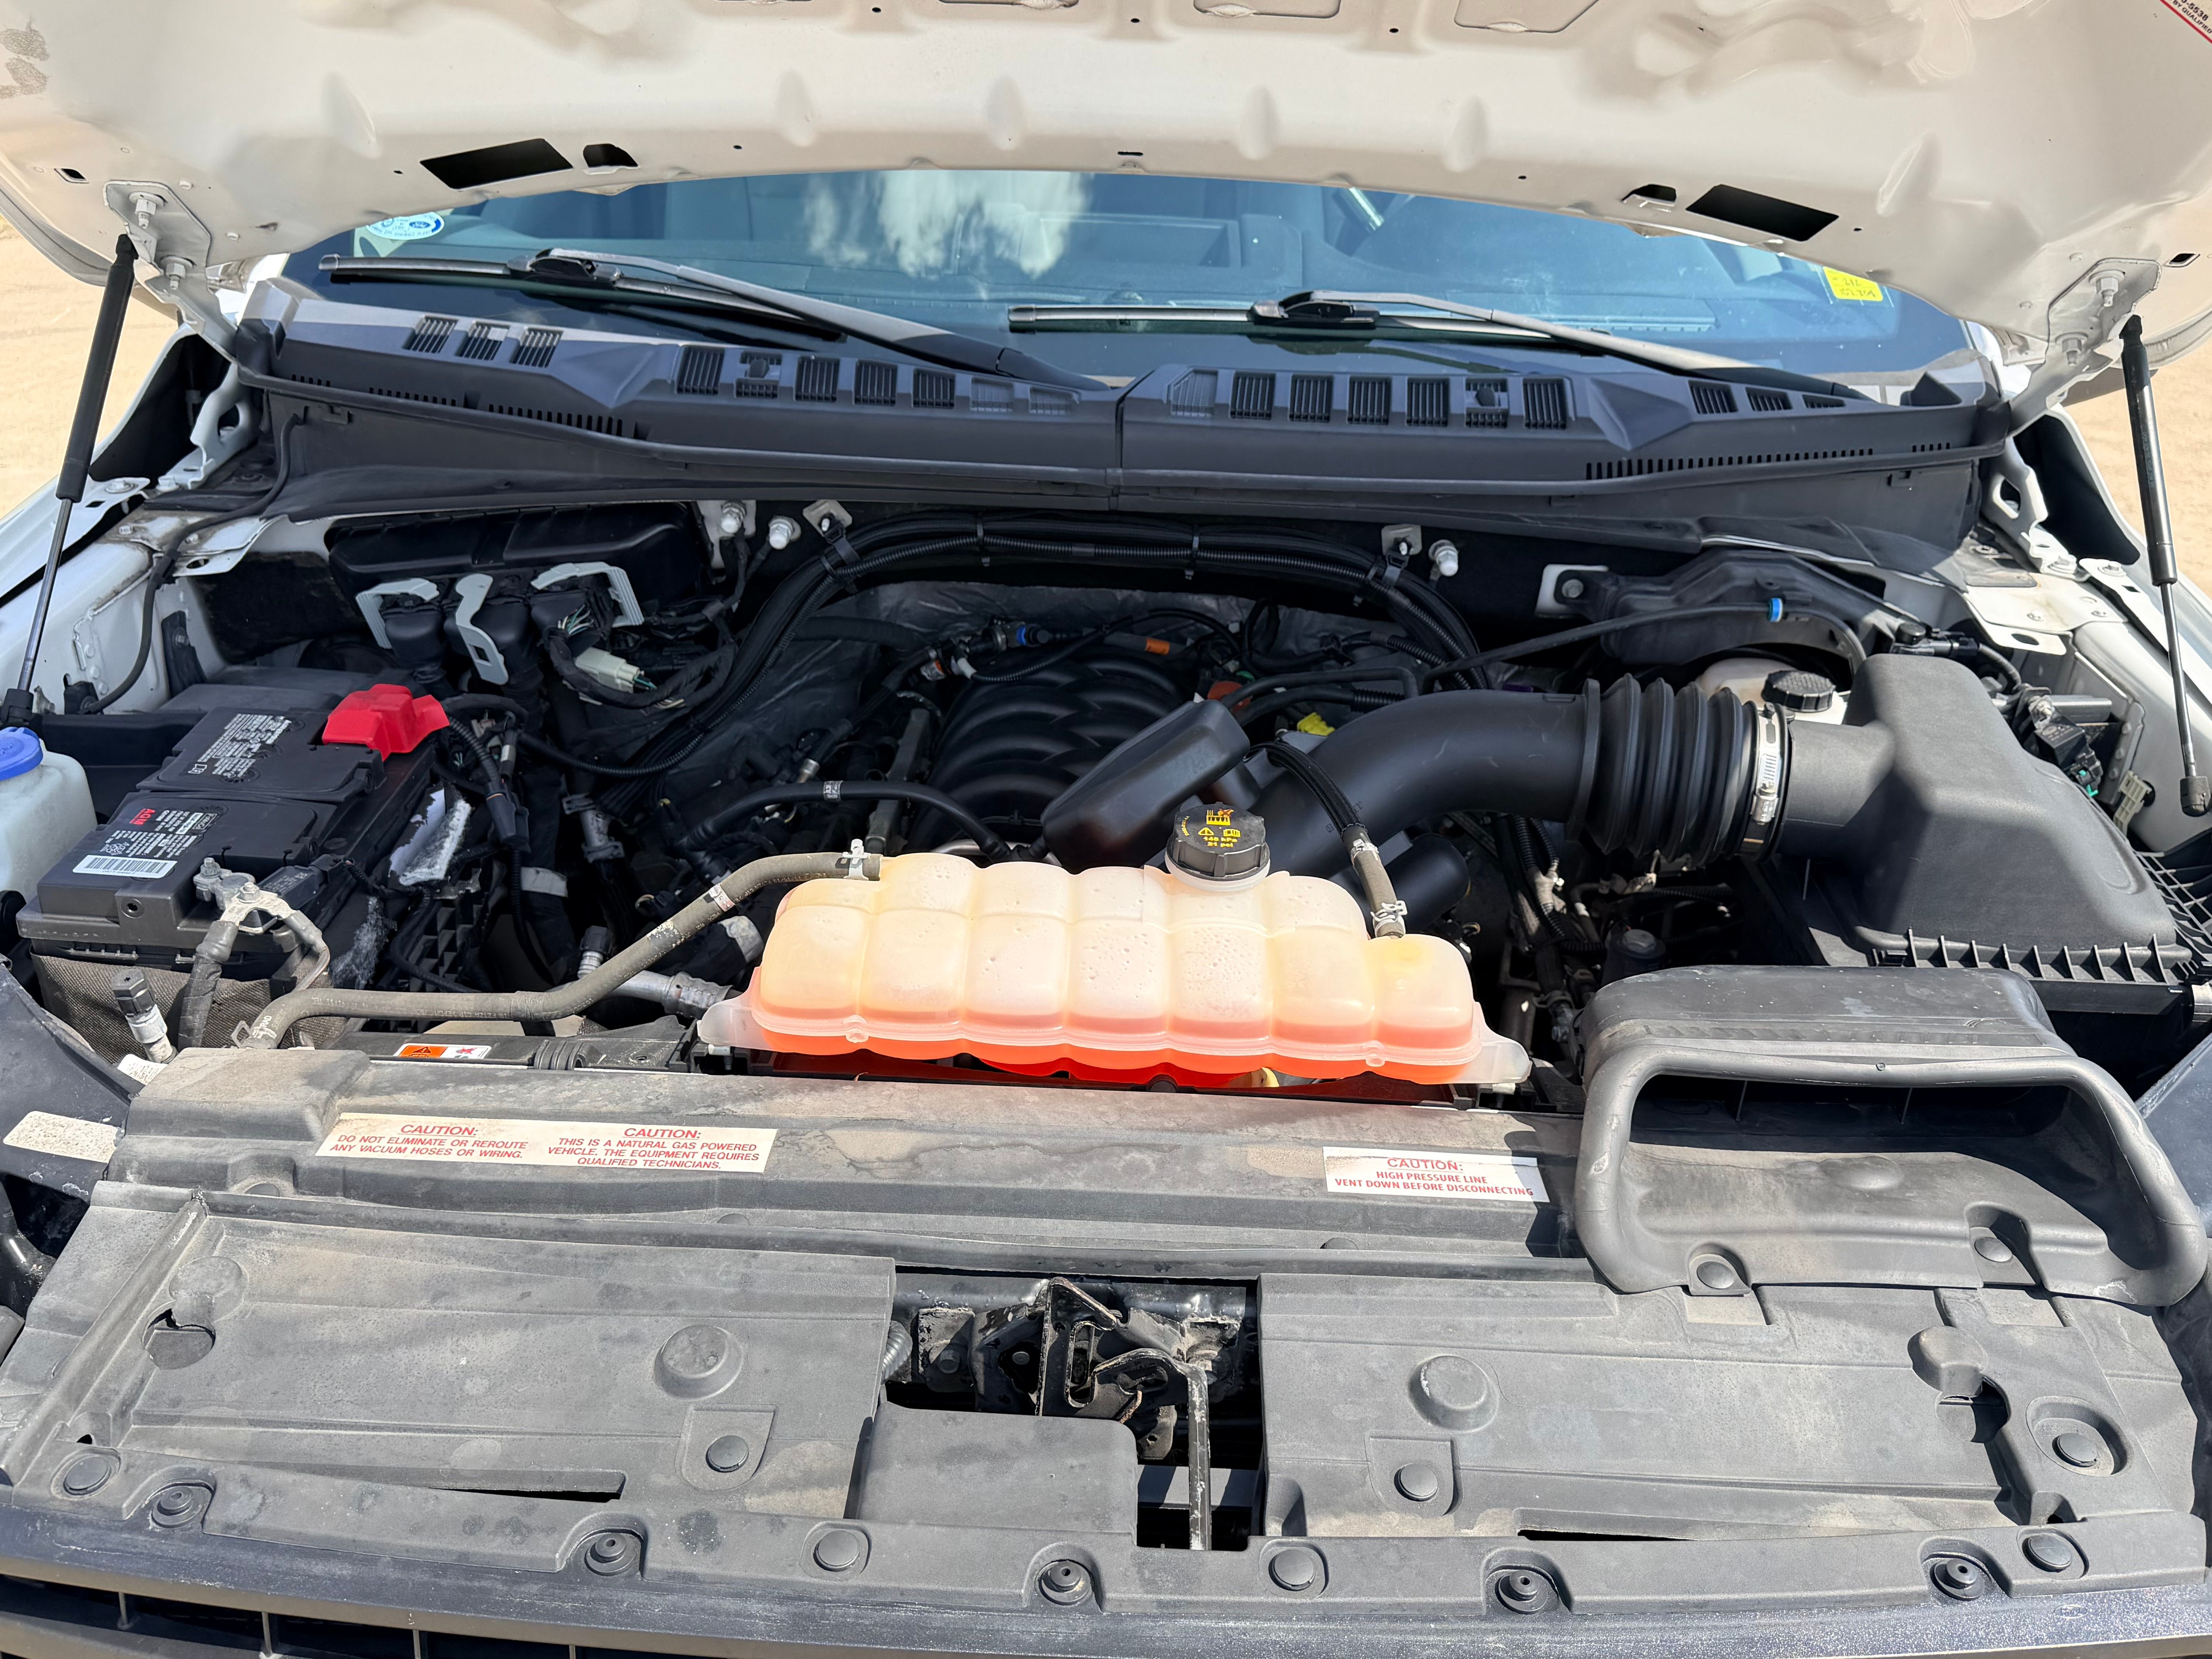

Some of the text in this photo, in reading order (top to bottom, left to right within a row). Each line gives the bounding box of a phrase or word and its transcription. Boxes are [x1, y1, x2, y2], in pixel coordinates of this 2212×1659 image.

[2182, 7, 2212, 34] QUALIFIED
[400, 1124, 478, 1136] CAUTION:
[624, 1128, 702, 1139] CAUTION:
[359, 1135, 385, 1144] NOT
[387, 1137, 445, 1147] ELIMINATE
[450, 1139, 467, 1147] OR
[474, 1140, 529, 1149] REROUTE
[558, 1138, 583, 1146] THIS
[617, 1140, 667, 1149] NATURAL
[672, 1142, 696, 1150] GAS
[700, 1142, 757, 1152] POWERED
[359, 1145, 407, 1154] VACUUM
[410, 1147, 453, 1156] HOSES
[457, 1148, 473, 1156] OR
[479, 1149, 523, 1158] WIRING.
[548, 1147, 759, 1161] VEHICLE. THE EQUIPMENT REQUIRES
[577, 1157, 721, 1169] QUALIFIED TECHNICIANS.
[1387, 1158, 1463, 1171] CAUTION:
[1376, 1171, 1487, 1184] HIGH PRESSURE LINE
[1335, 1178, 1534, 1196] VENT DOWN BEFORE DISCONNECTING
